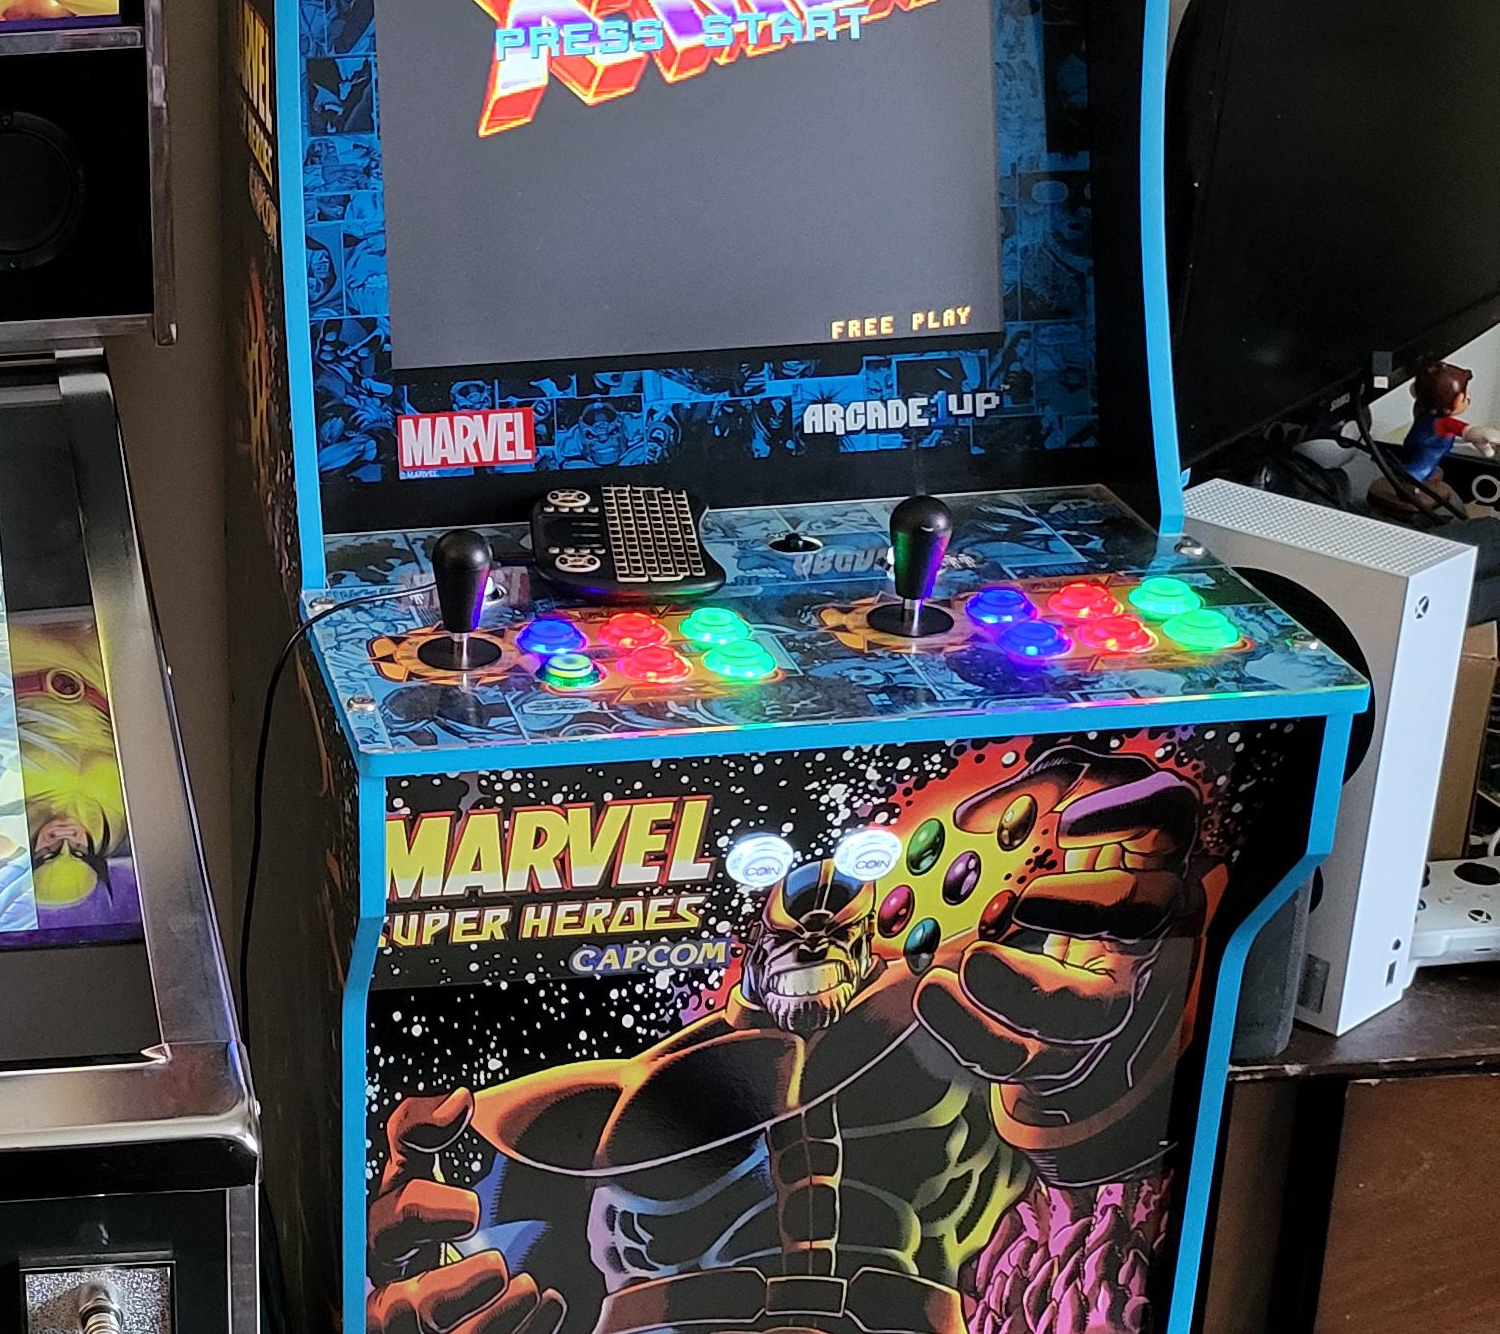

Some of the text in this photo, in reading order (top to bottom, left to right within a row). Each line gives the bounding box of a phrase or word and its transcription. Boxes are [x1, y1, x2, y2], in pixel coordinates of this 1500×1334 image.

[496, 7, 871, 61] PRESS START
[831, 305, 973, 339] FREE PLAY
[401, 411, 532, 466] MARVEL
[385, 796, 715, 901] MARVEL
[745, 859, 892, 877] COIN COIN
[522, 895, 709, 940] HEROES
[570, 938, 731, 973] CAPCOM
